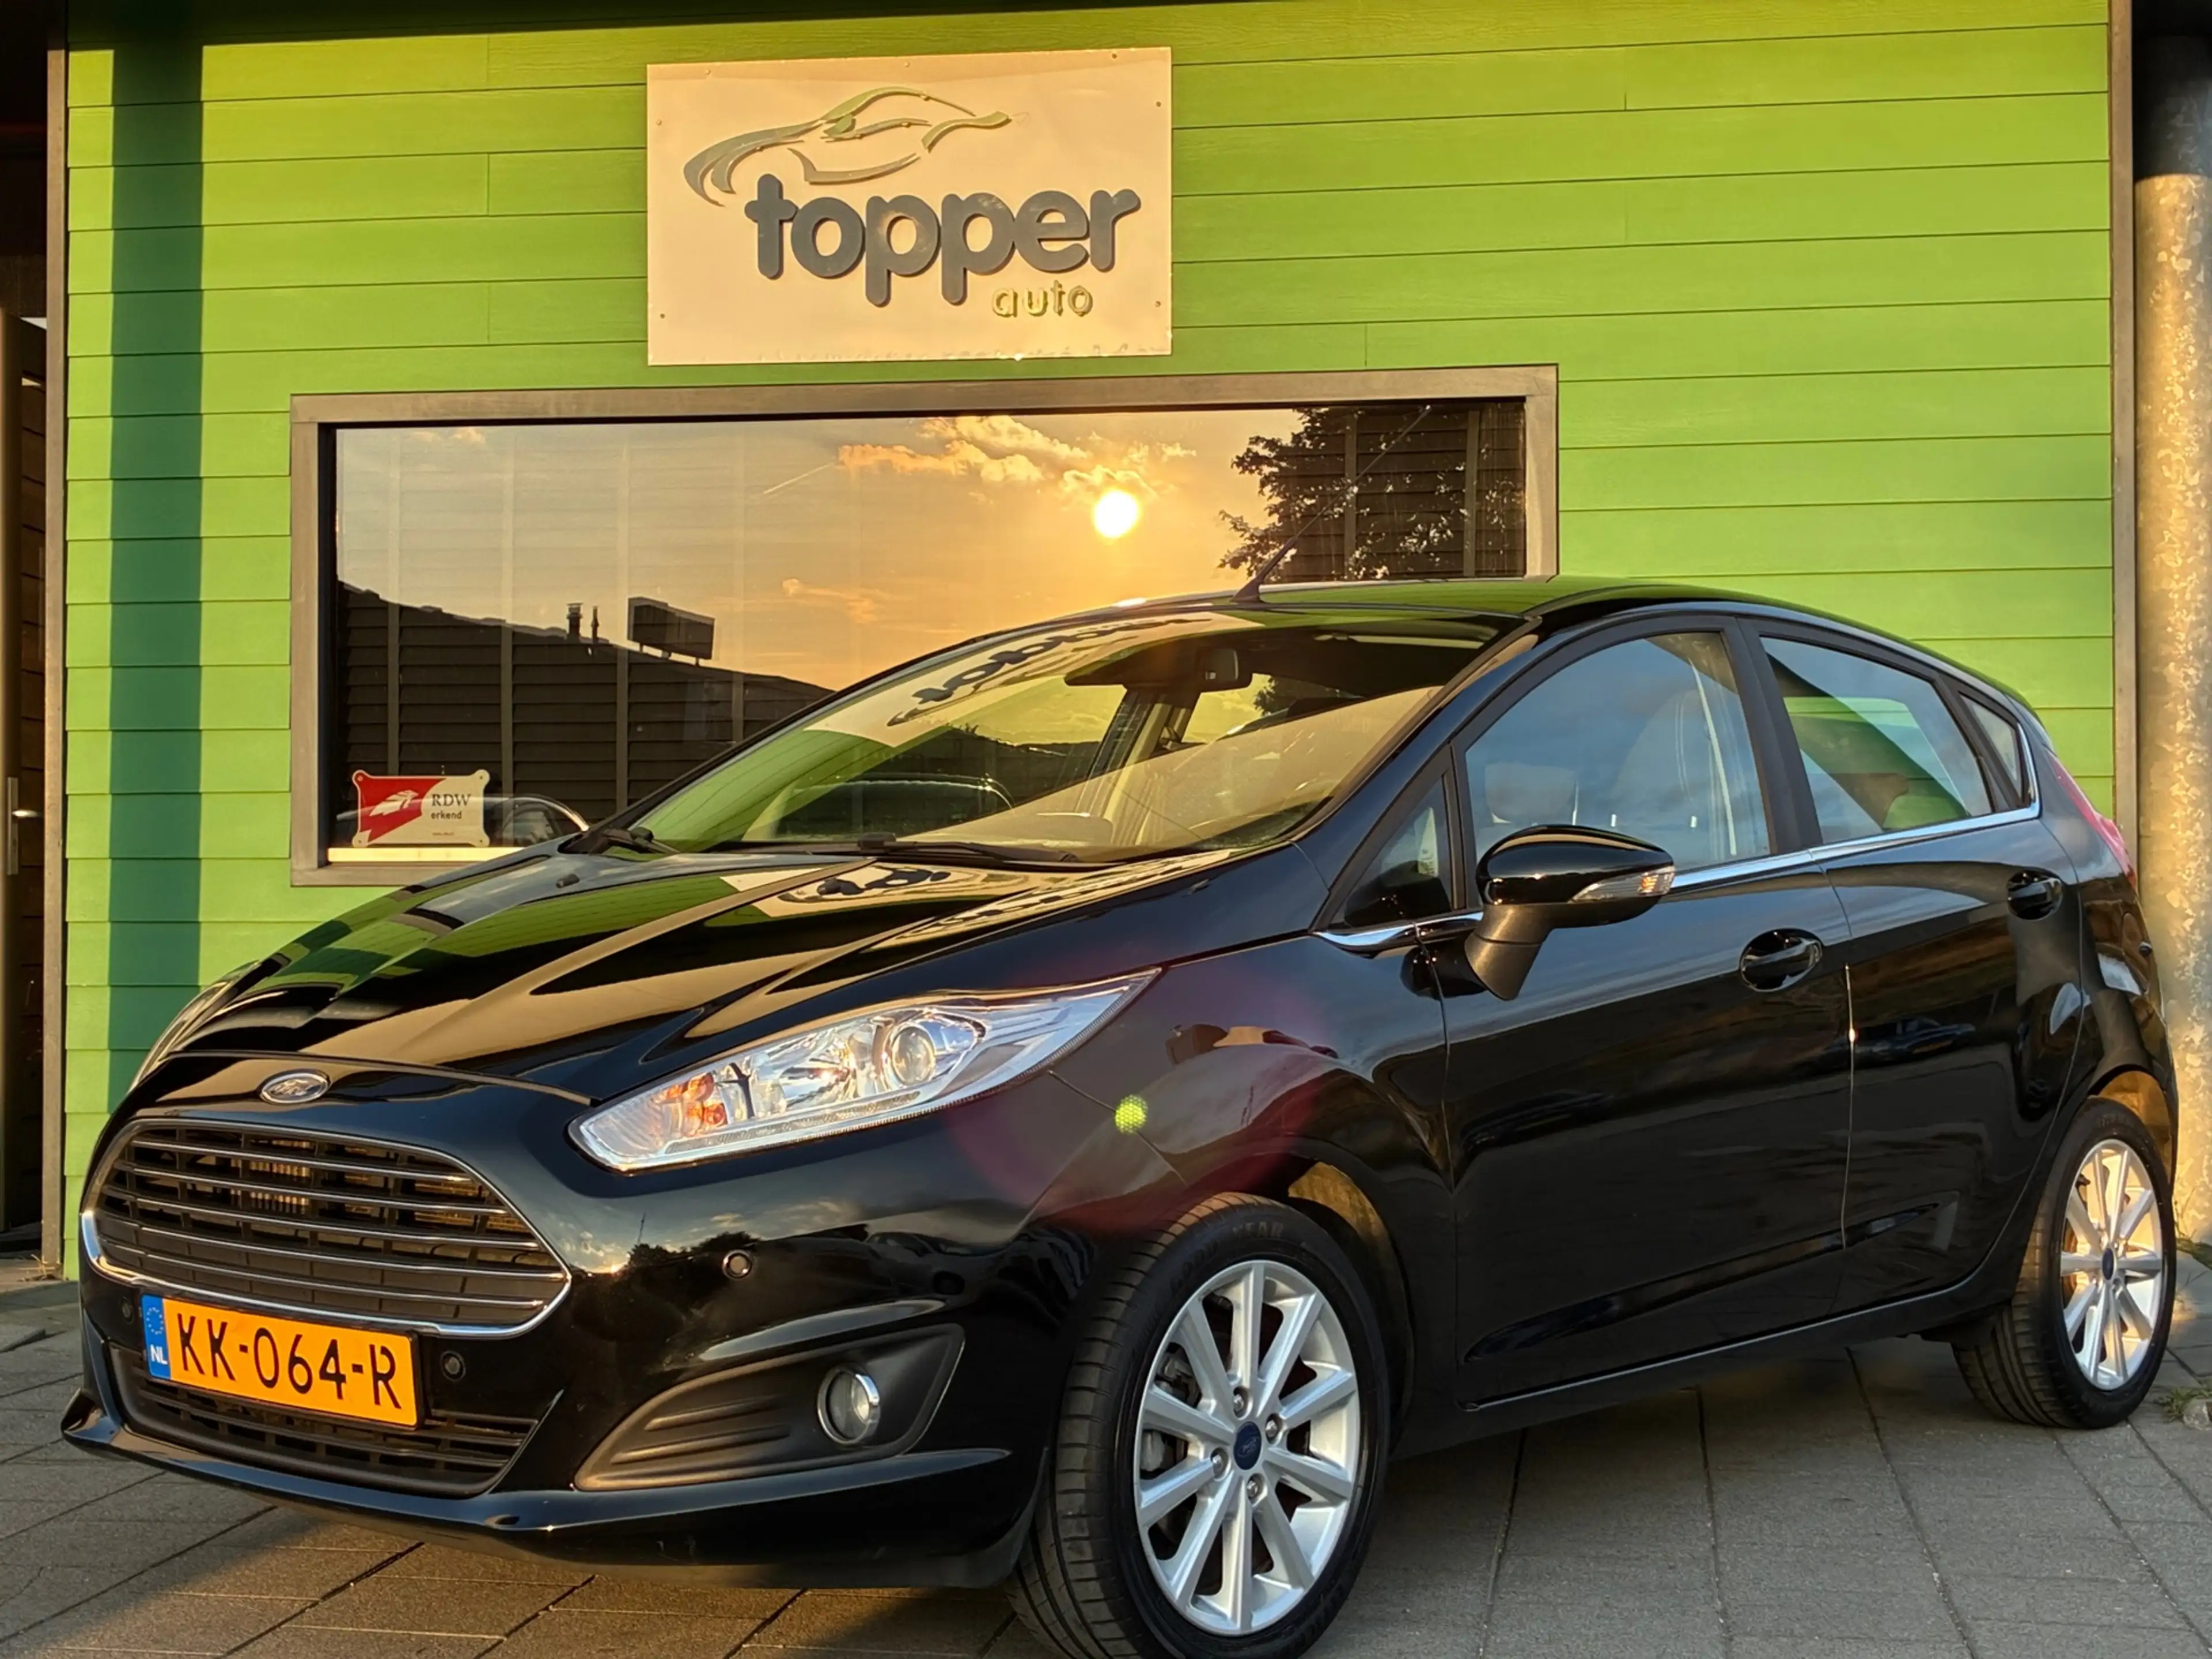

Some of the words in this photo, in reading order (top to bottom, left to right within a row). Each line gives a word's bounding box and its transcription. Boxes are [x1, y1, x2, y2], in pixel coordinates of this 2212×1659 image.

[744, 173, 1141, 306] topper
[993, 280, 1093, 317] auto
[431, 794, 472, 806] RDW
[431, 810, 462, 819] erkend
[150, 1344, 168, 1365] NL
[177, 1313, 402, 1410] KK-064-R
